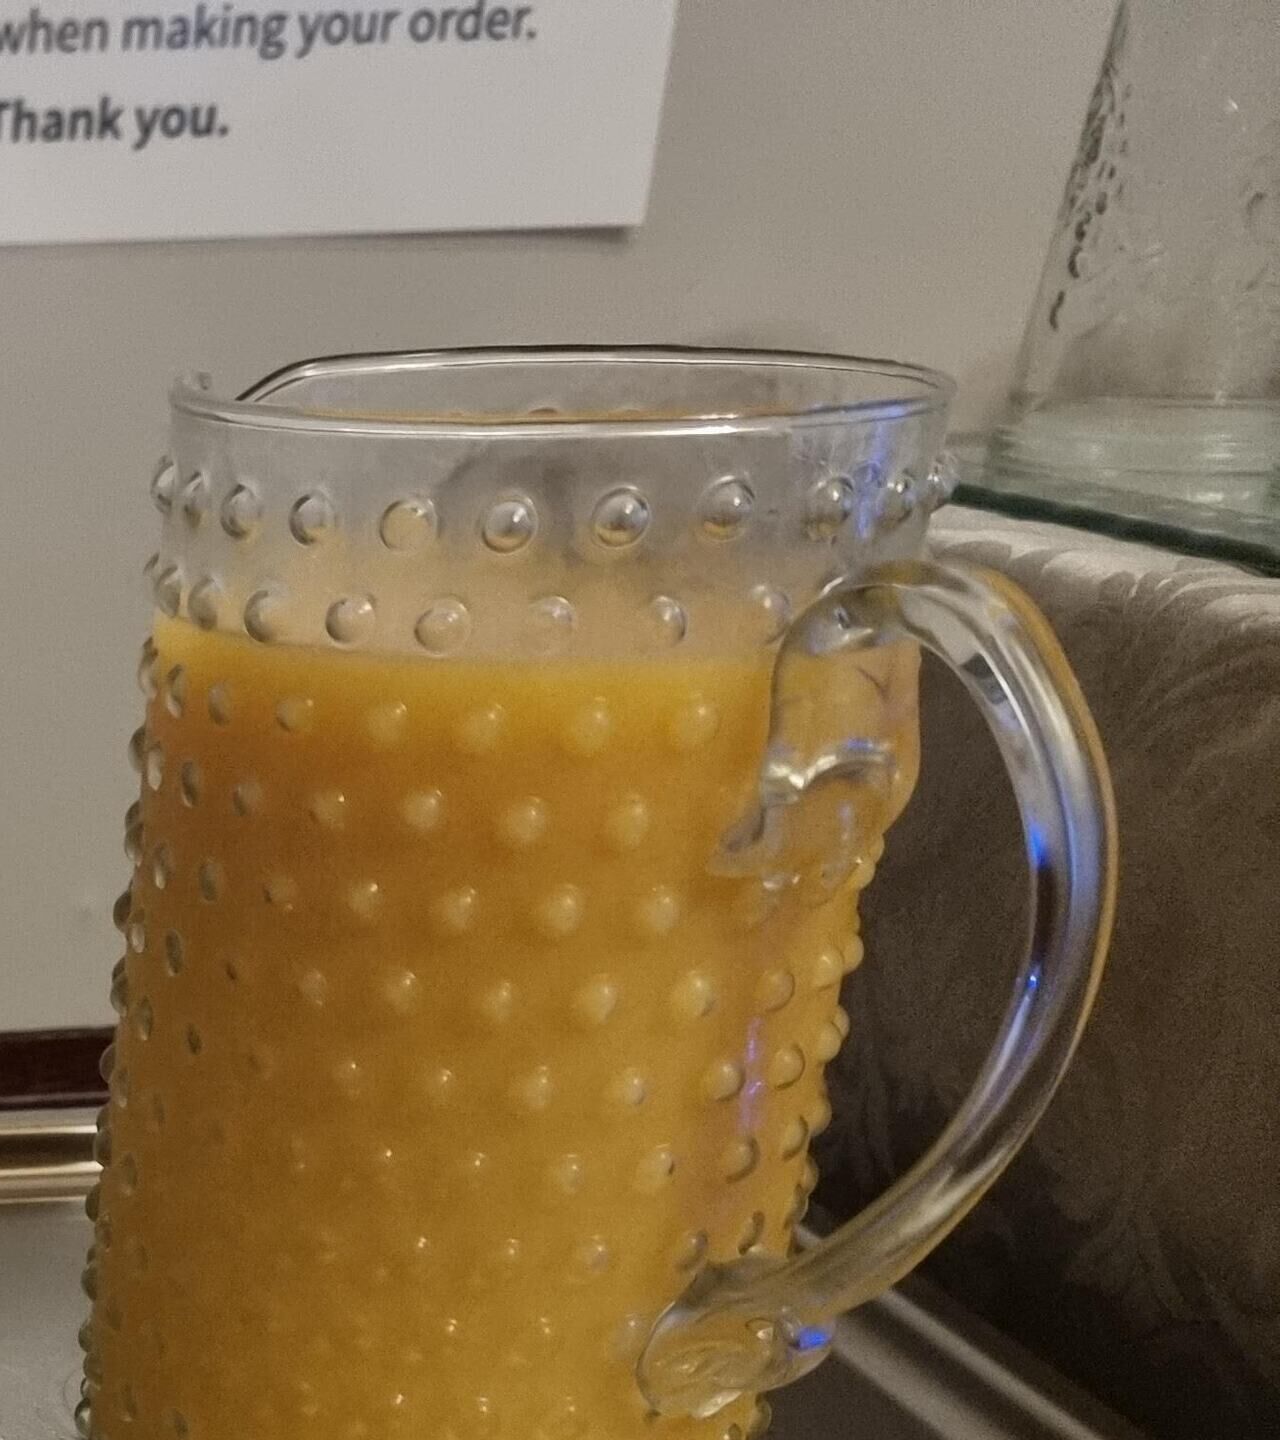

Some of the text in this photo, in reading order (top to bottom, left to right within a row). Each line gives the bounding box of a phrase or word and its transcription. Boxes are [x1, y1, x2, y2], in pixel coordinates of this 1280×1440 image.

[121, 3, 287, 60] making
[295, 9, 401, 59] your
[407, 0, 537, 43] order.
[131, 102, 229, 151] you.
